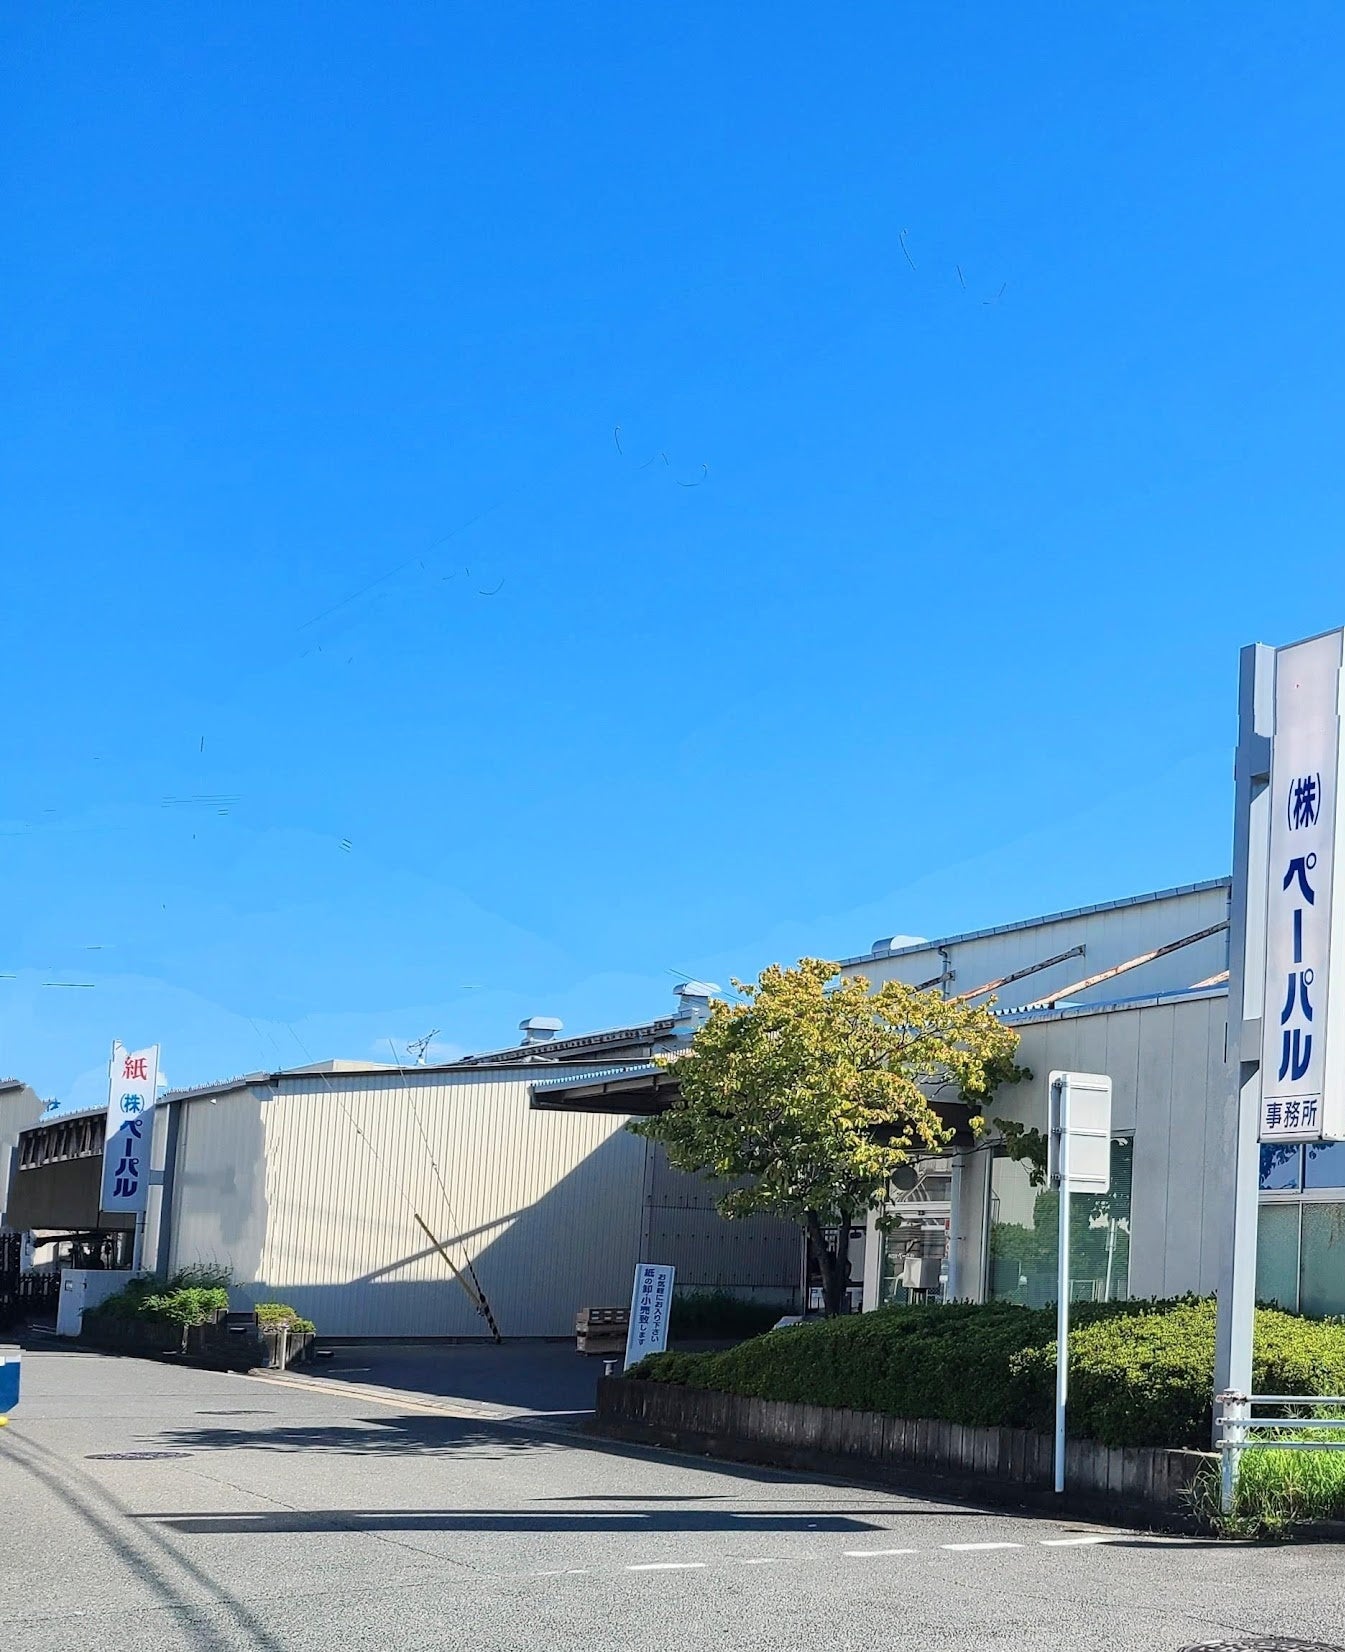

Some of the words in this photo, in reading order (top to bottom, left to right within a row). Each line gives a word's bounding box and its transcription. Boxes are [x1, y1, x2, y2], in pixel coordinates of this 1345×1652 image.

[122, 1055, 148, 1081] 紙
[1265, 1098, 1318, 1130] 事務所
[651, 1274, 666, 1343] お気軽にお入り下さい
